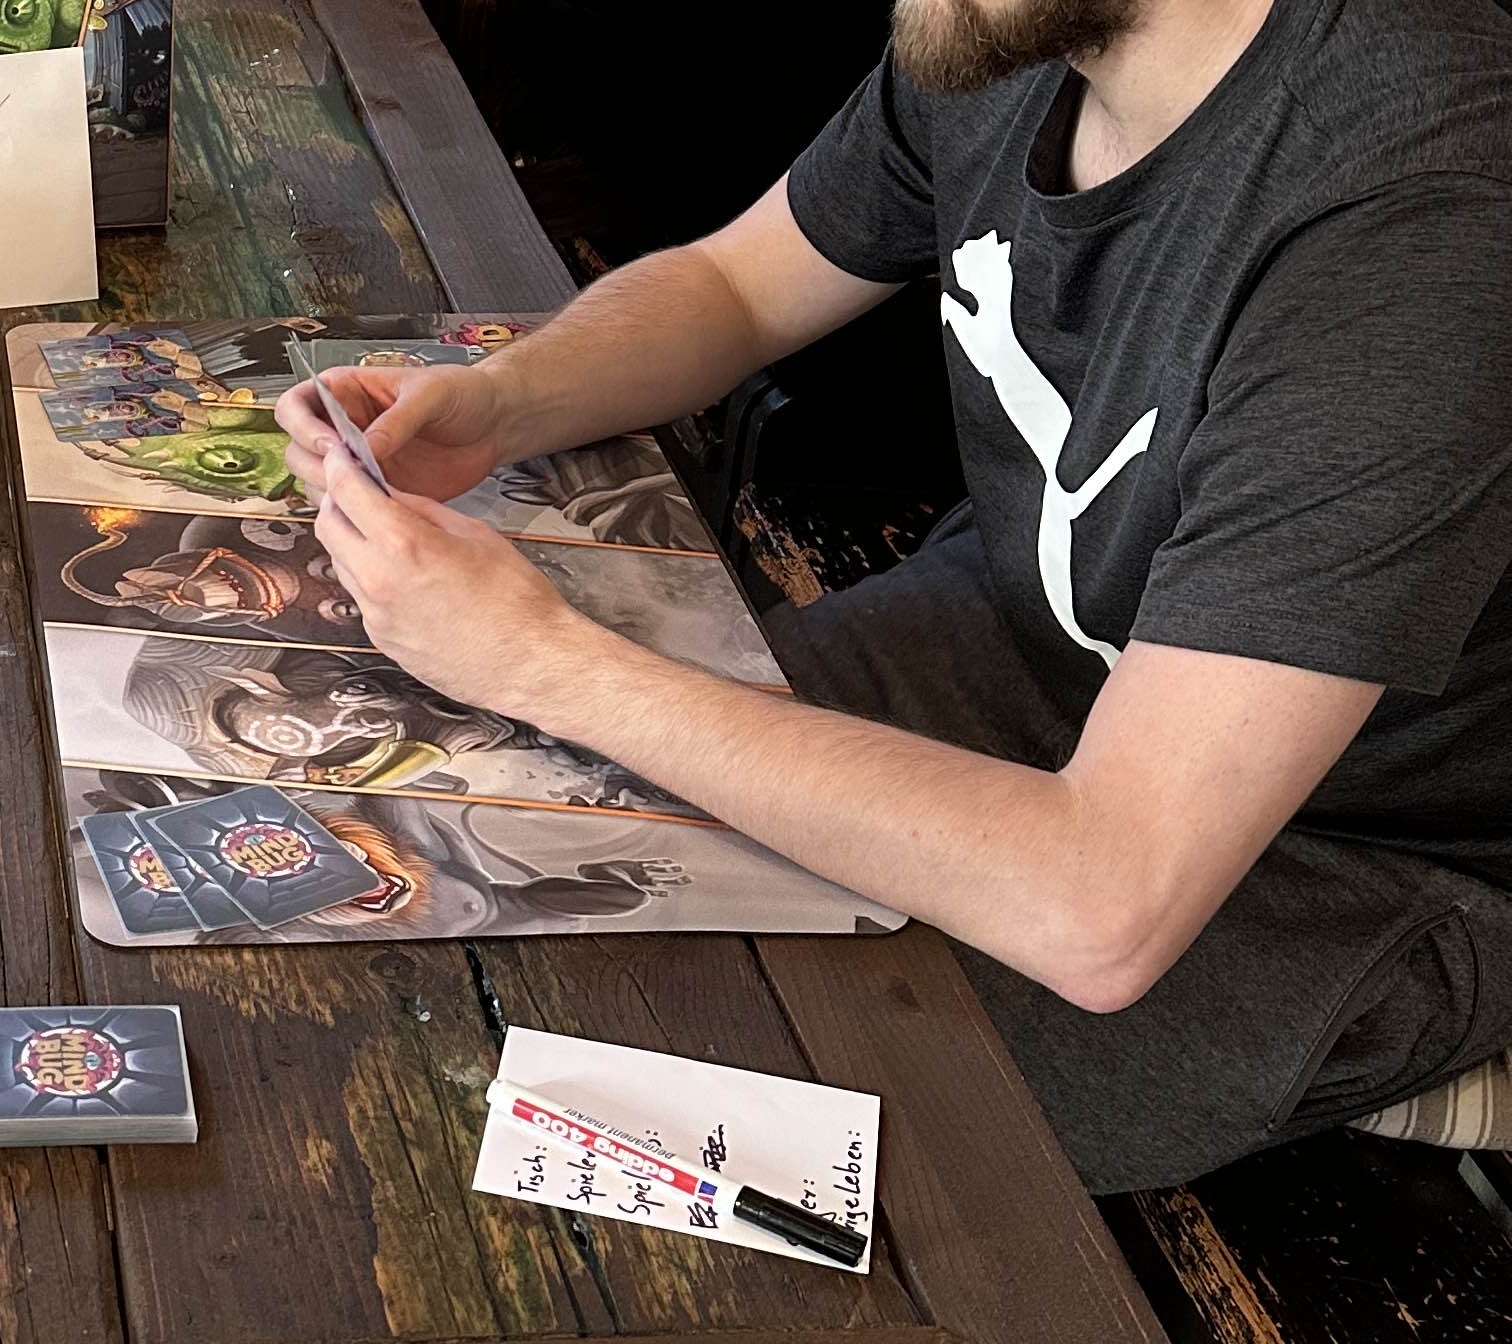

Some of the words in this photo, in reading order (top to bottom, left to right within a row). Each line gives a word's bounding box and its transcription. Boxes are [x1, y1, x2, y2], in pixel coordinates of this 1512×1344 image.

[232, 832, 301, 865] MIND
[246, 846, 306, 873] BUG
[35, 1038, 65, 1087] BUG
[60, 1033, 90, 1091] MIND
[531, 1110, 588, 1144] 400
[593, 1136, 676, 1183] edding
